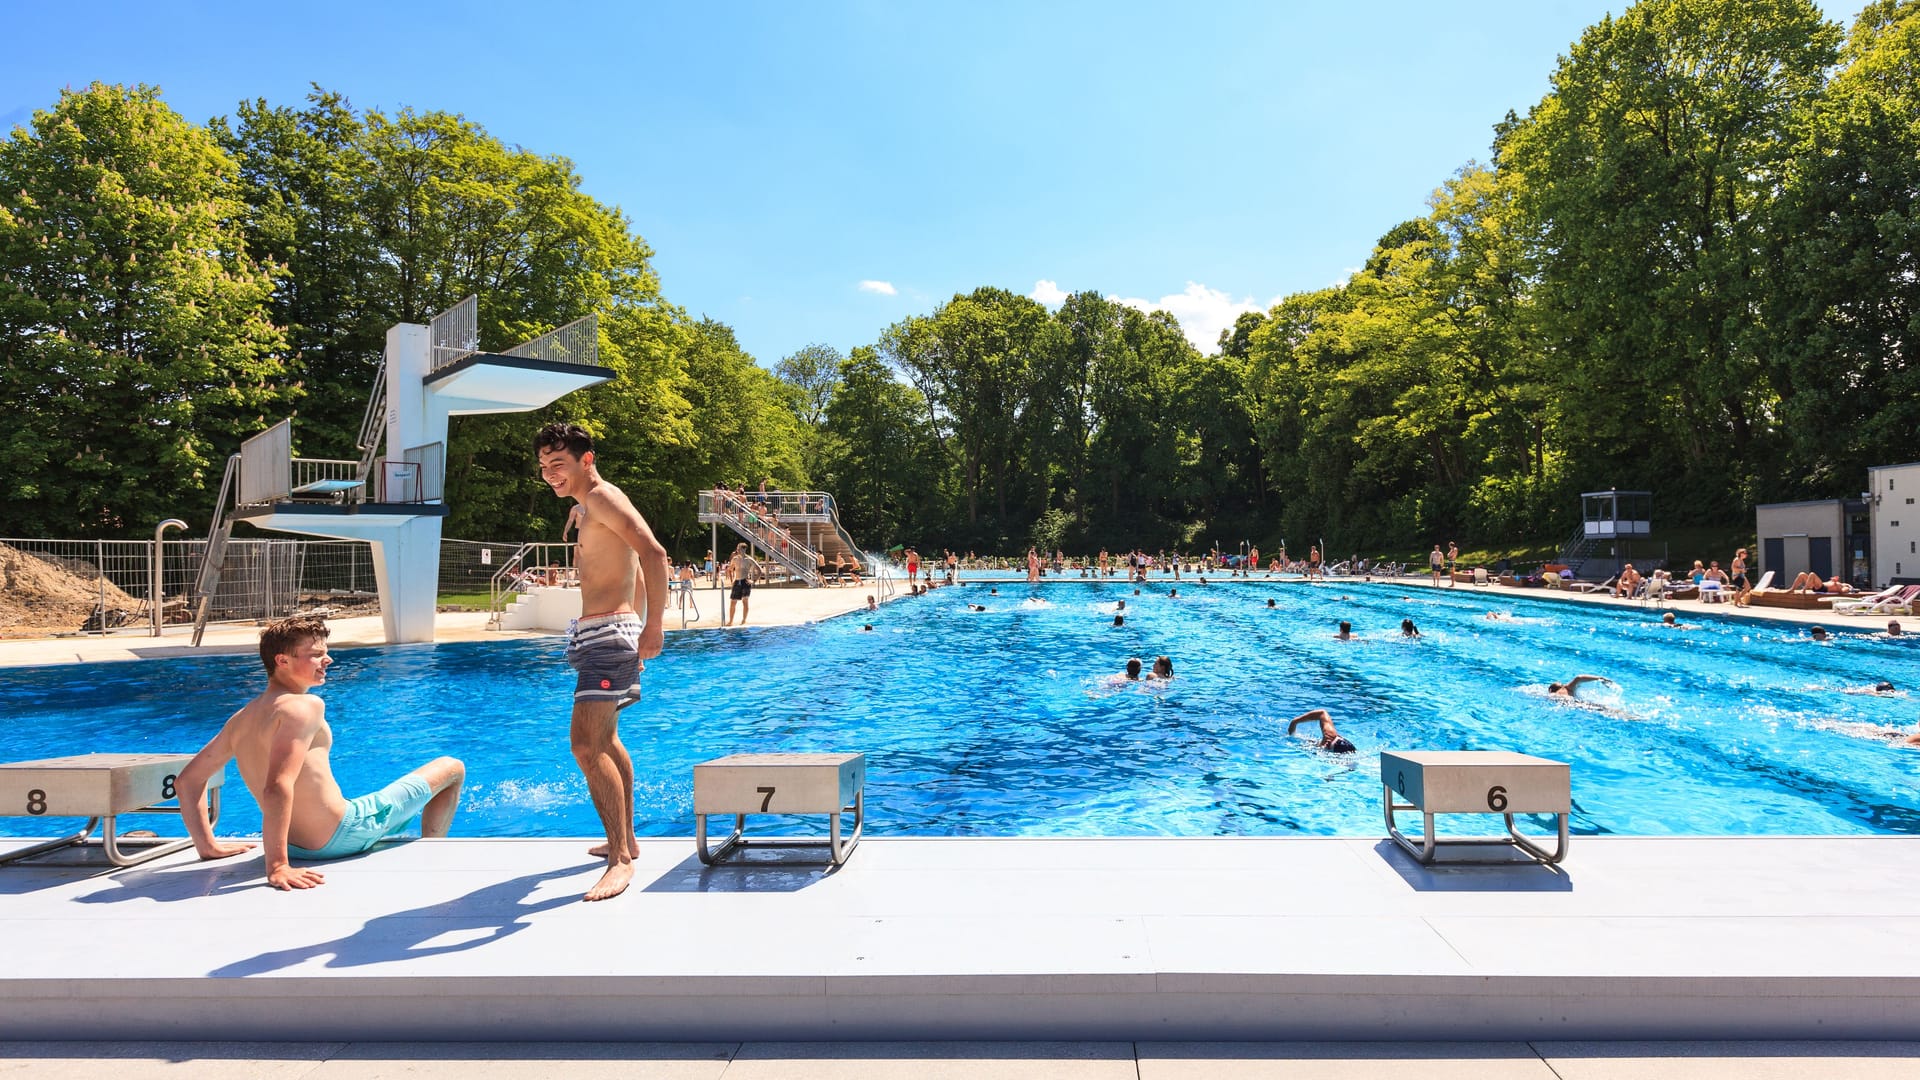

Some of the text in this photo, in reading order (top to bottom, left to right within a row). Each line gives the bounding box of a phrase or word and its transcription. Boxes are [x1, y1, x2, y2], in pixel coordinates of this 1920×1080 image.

[161, 774, 177, 800] 8
[756, 786, 776, 813] 7
[1487, 785, 1508, 812] 6
[26, 788, 48, 816] 8
